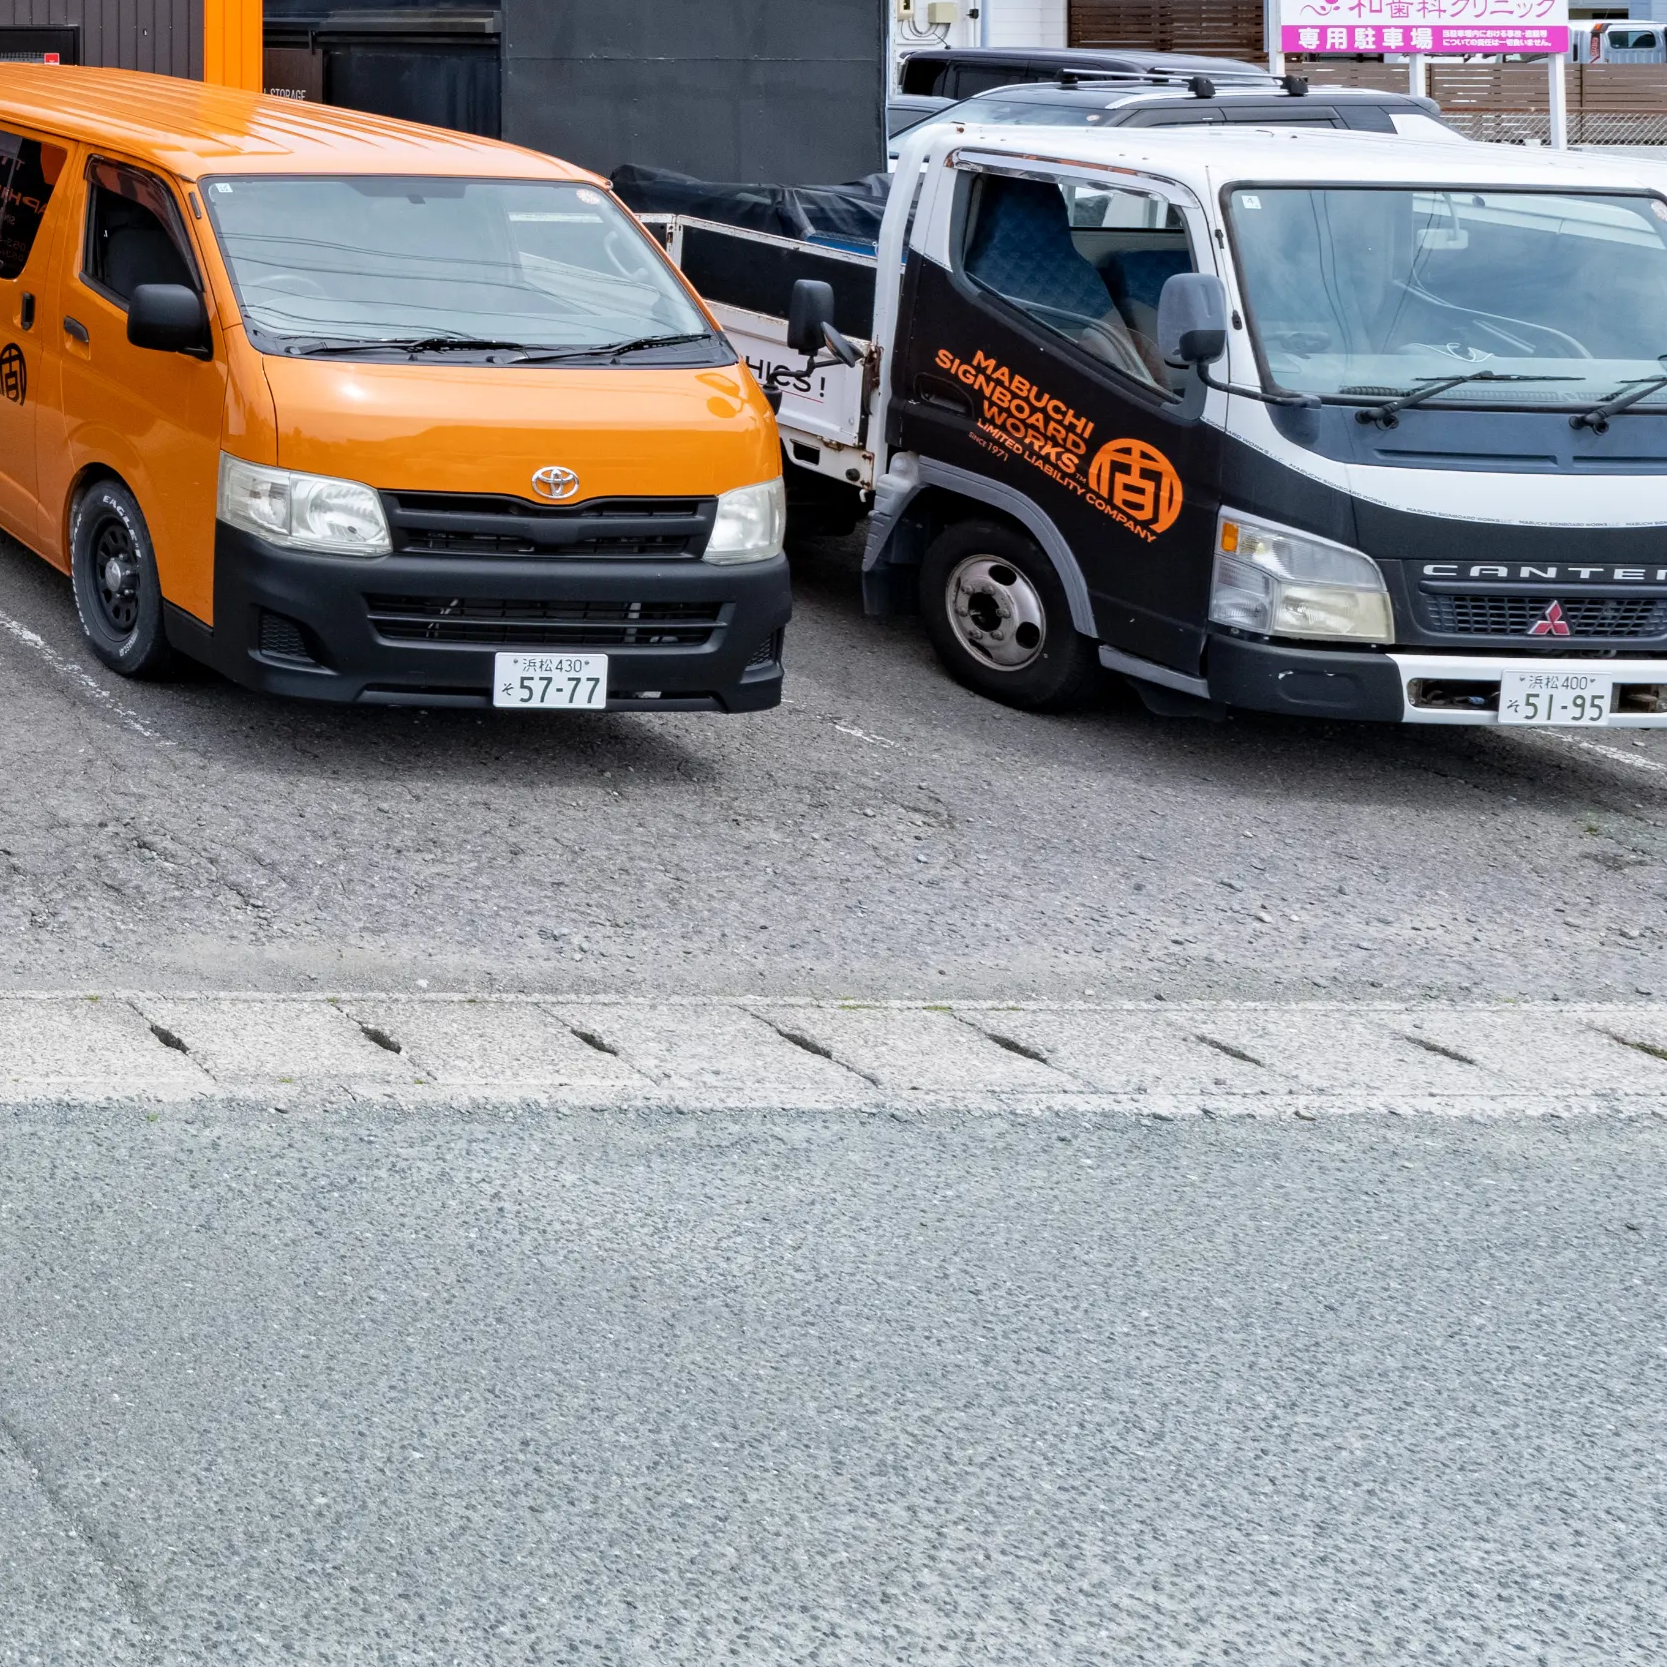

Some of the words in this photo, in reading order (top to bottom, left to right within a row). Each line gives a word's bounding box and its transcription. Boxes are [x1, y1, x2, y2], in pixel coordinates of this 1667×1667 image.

[1298, 27, 1433, 50] 専用駐車場
[935, 349, 1087, 455] SIGNBOARD
[972, 349, 1095, 439] MABUCHI
[968, 431, 987, 447] SINCE
[987, 440, 1009, 462] 1971
[982, 400, 1080, 474] WORKS
[976, 418, 1024, 455] LIMITED
[1023, 451, 1085, 497] LIABILITY
[1085, 492, 1158, 544] COMPANY
[1243, 437, 1270, 455] WORKS
[1289, 463, 1322, 481] MABUCHI
[1323, 479, 1362, 497] SIGNBOARD
[1363, 494, 1388, 506] WORKS
[1406, 507, 1437, 515] MABUCHI
[1438, 512, 1476, 520] SIGNBOARD
[519, 676, 600, 703] 57-77
[1524, 693, 1605, 721] 51-95
